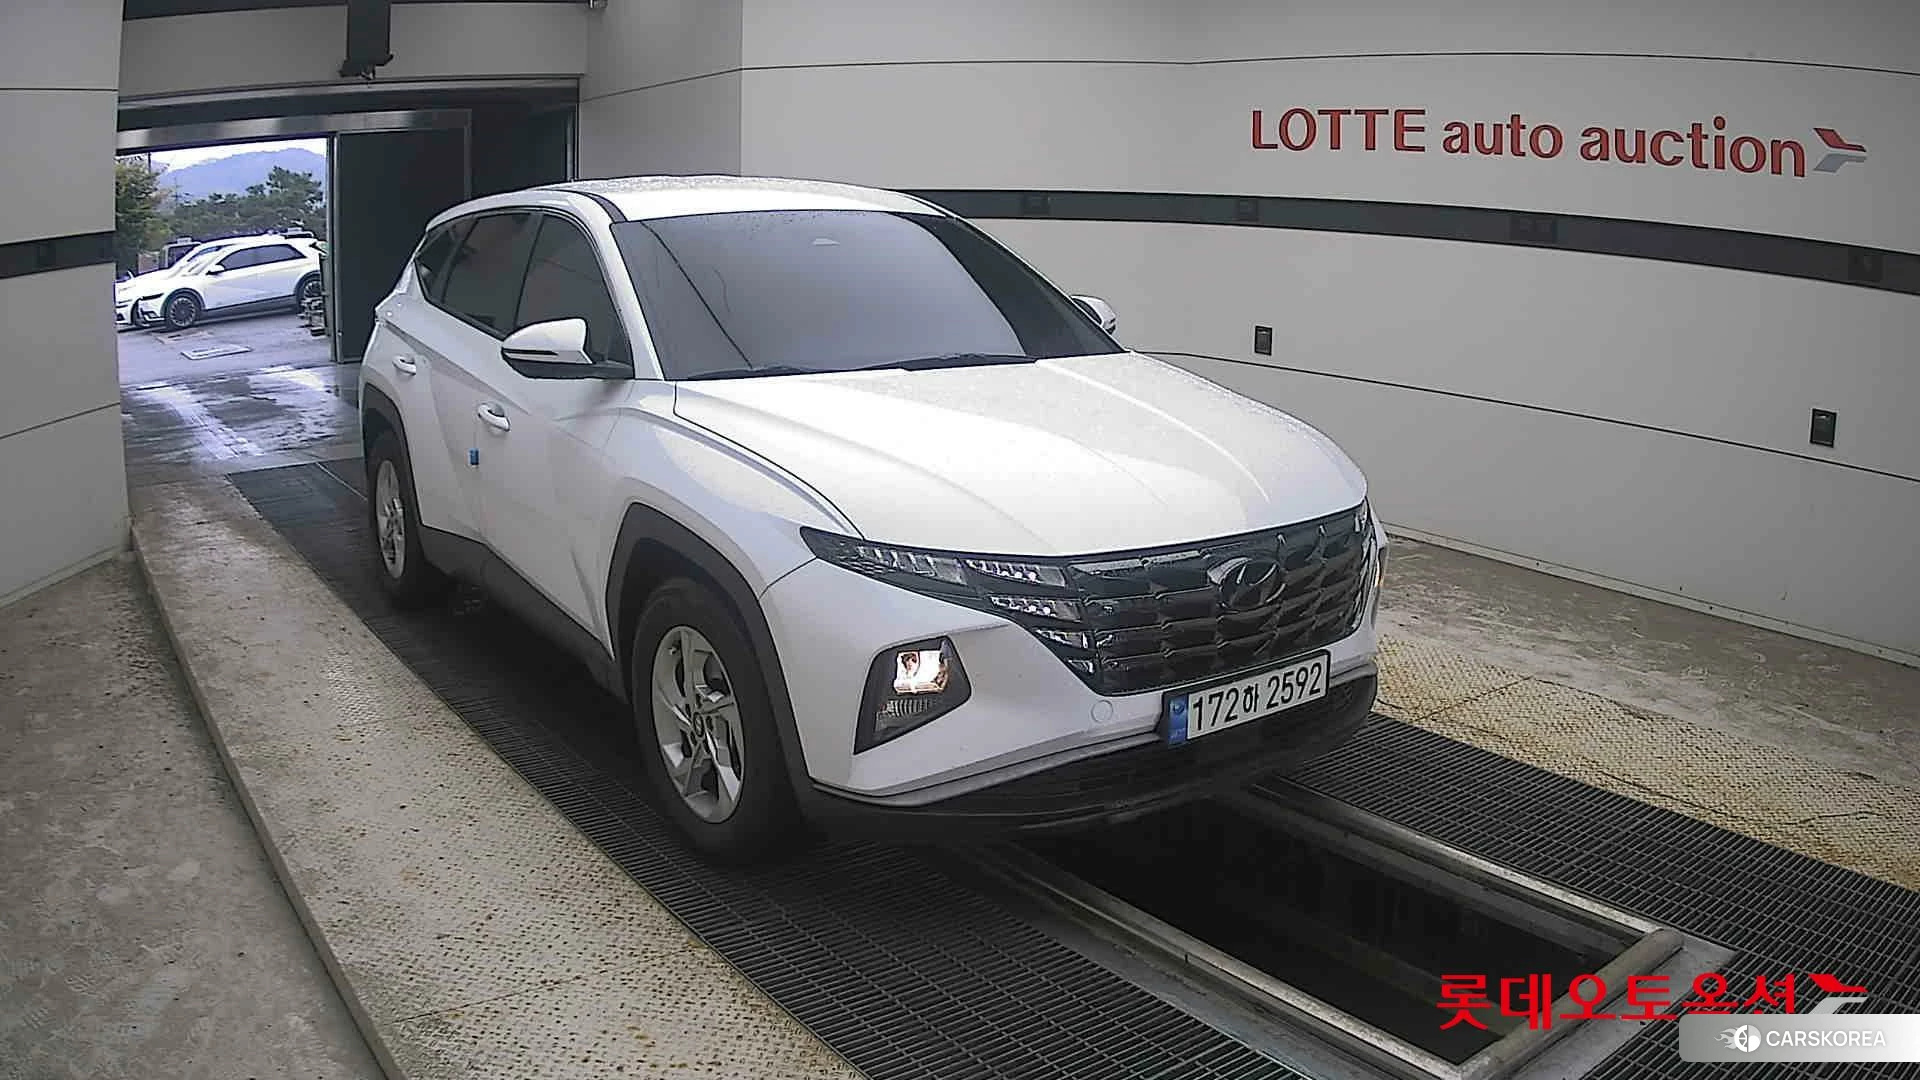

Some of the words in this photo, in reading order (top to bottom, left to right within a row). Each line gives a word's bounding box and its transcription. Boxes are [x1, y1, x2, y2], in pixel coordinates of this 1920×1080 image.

[1252, 107, 1426, 152] LOTTE
[1442, 113, 1563, 159] auto
[1579, 116, 1806, 178] auction
[1193, 683, 1260, 731] 172하
[1265, 662, 1322, 711] 2592
